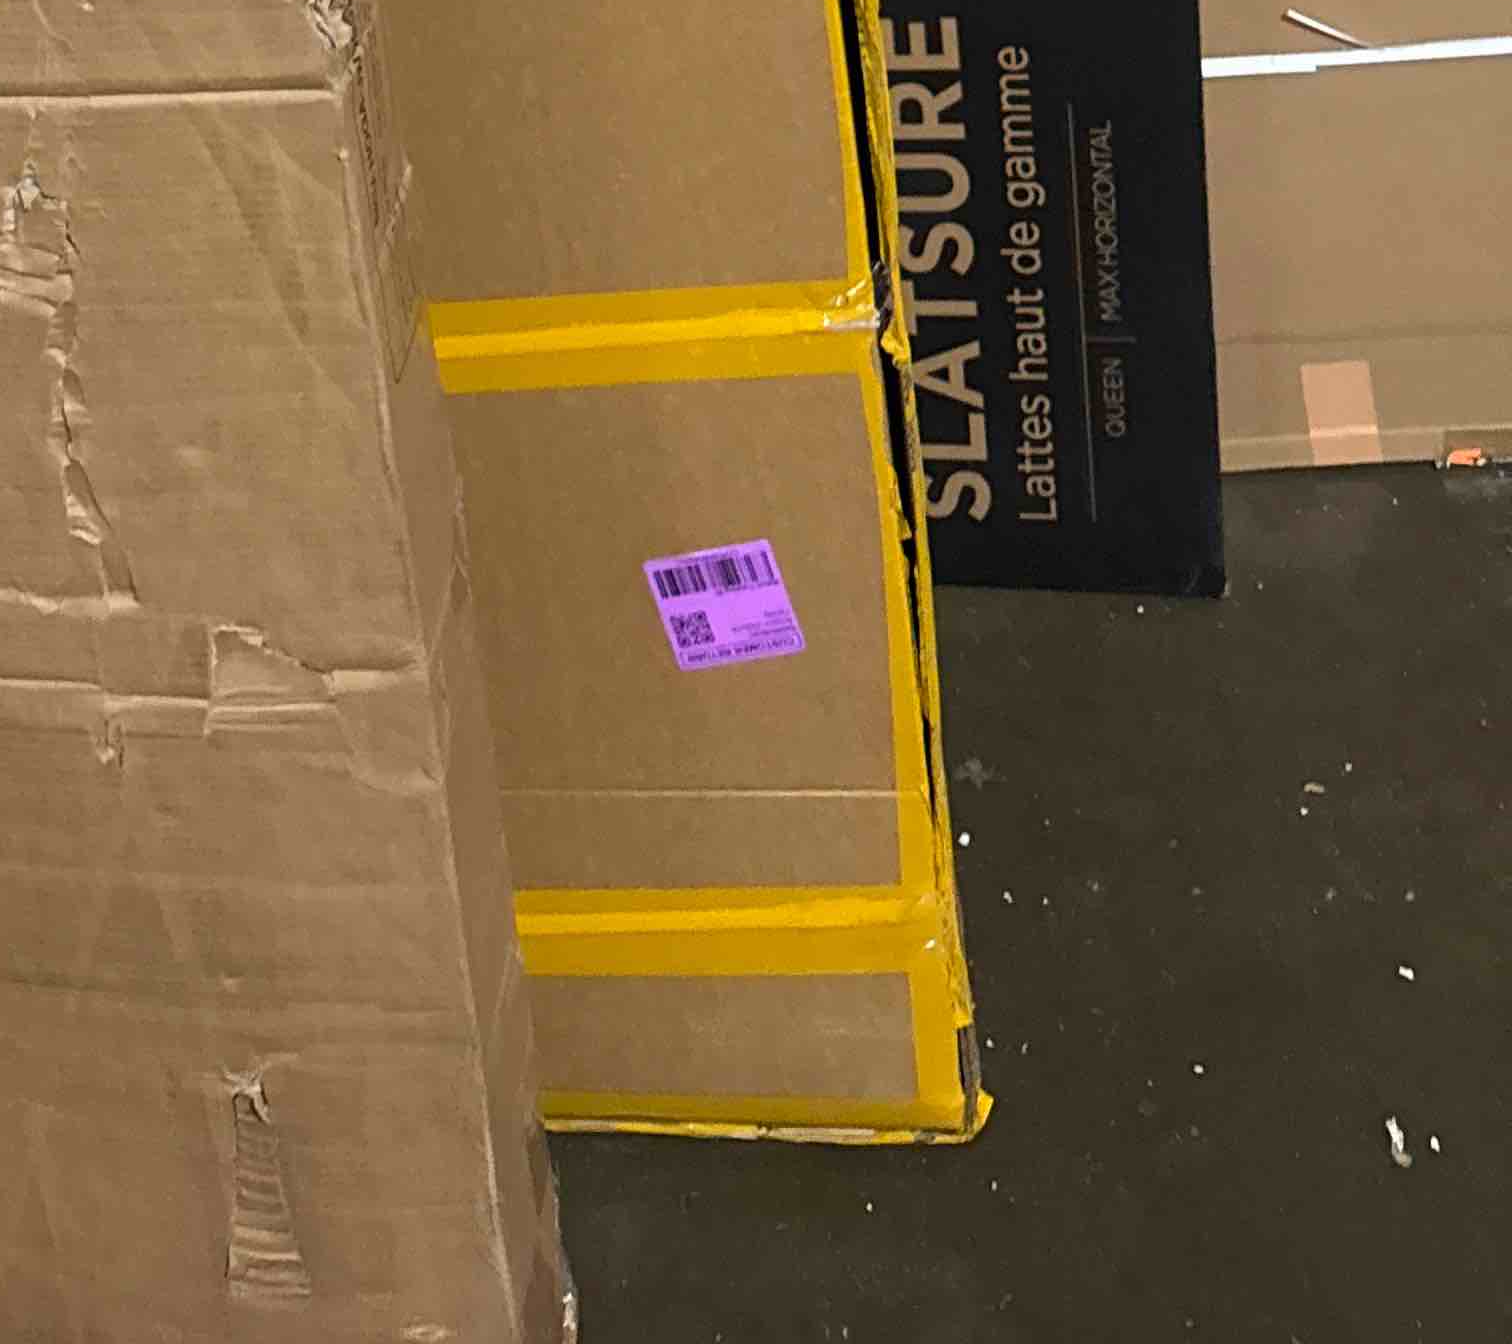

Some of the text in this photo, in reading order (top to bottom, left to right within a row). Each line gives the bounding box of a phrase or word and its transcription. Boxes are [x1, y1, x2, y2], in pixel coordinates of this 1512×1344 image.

[881, 15, 993, 522] SLATSURE
[997, 45, 1058, 522] Lattes haut de gamme
[1104, 357, 1127, 438] QUEEN
